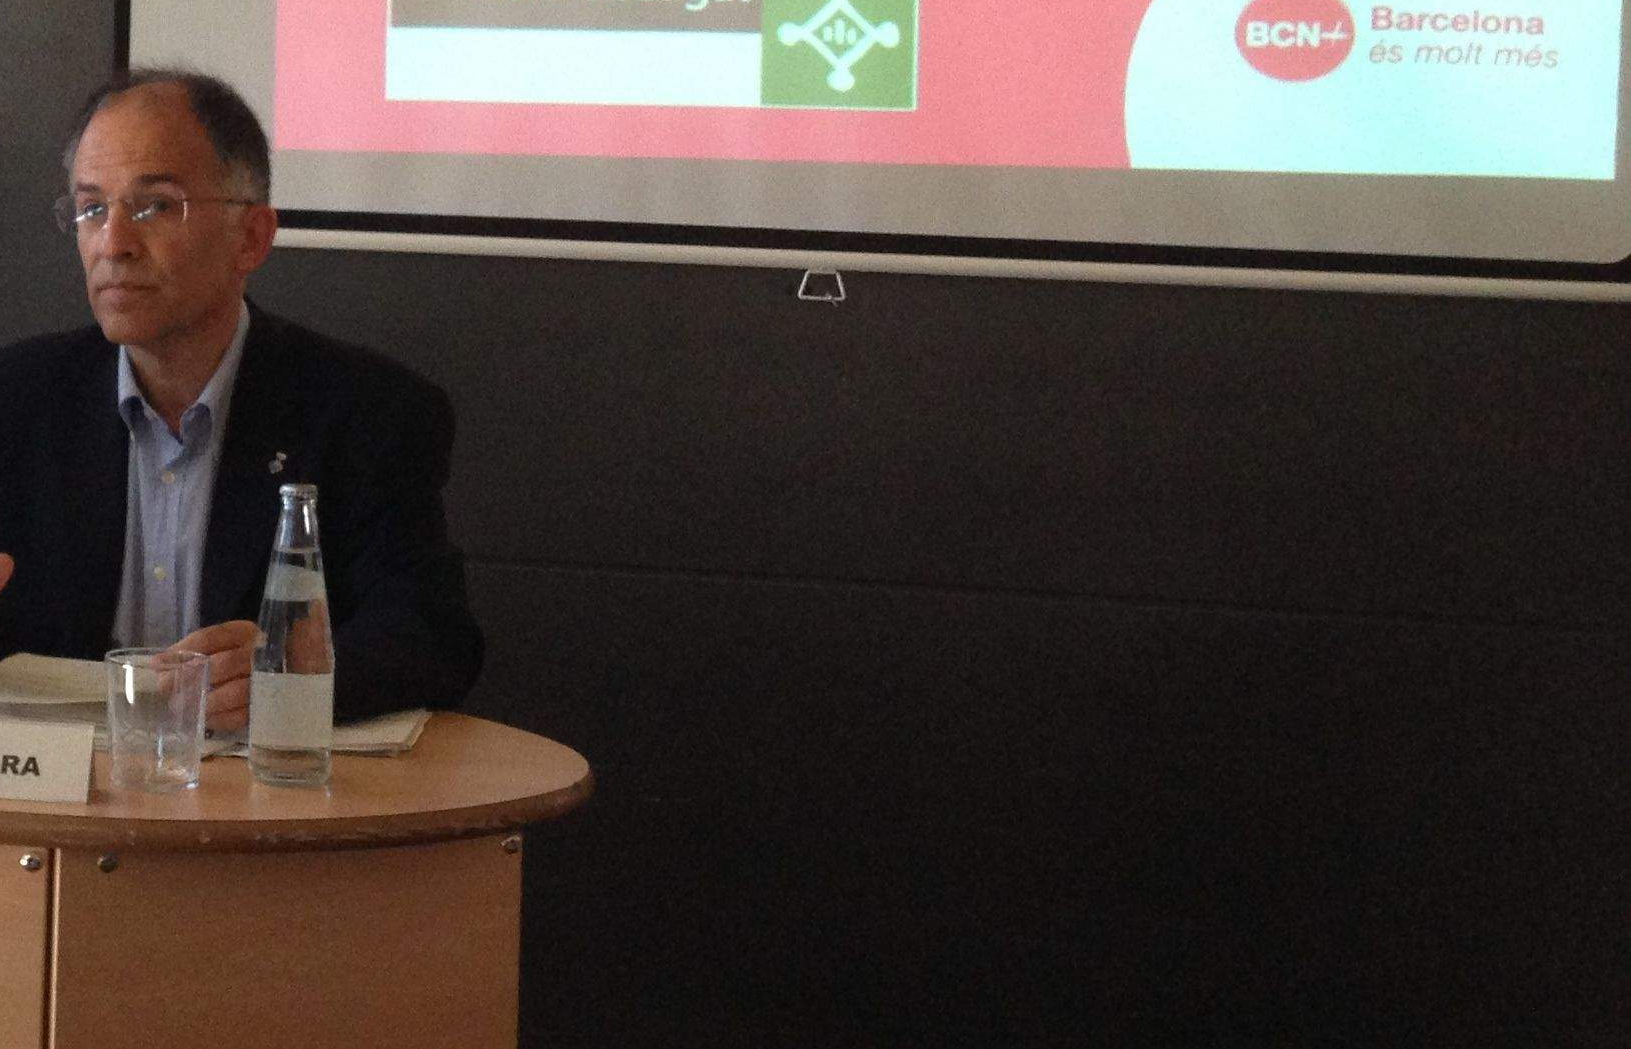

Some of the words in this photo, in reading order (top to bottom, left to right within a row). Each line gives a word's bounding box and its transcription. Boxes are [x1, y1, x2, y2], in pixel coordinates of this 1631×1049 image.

[1370, 6, 1545, 36] Barcelona
[1368, 39, 1403, 64] és
[1414, 40, 1483, 66] molt
[1493, 42, 1560, 69] més
